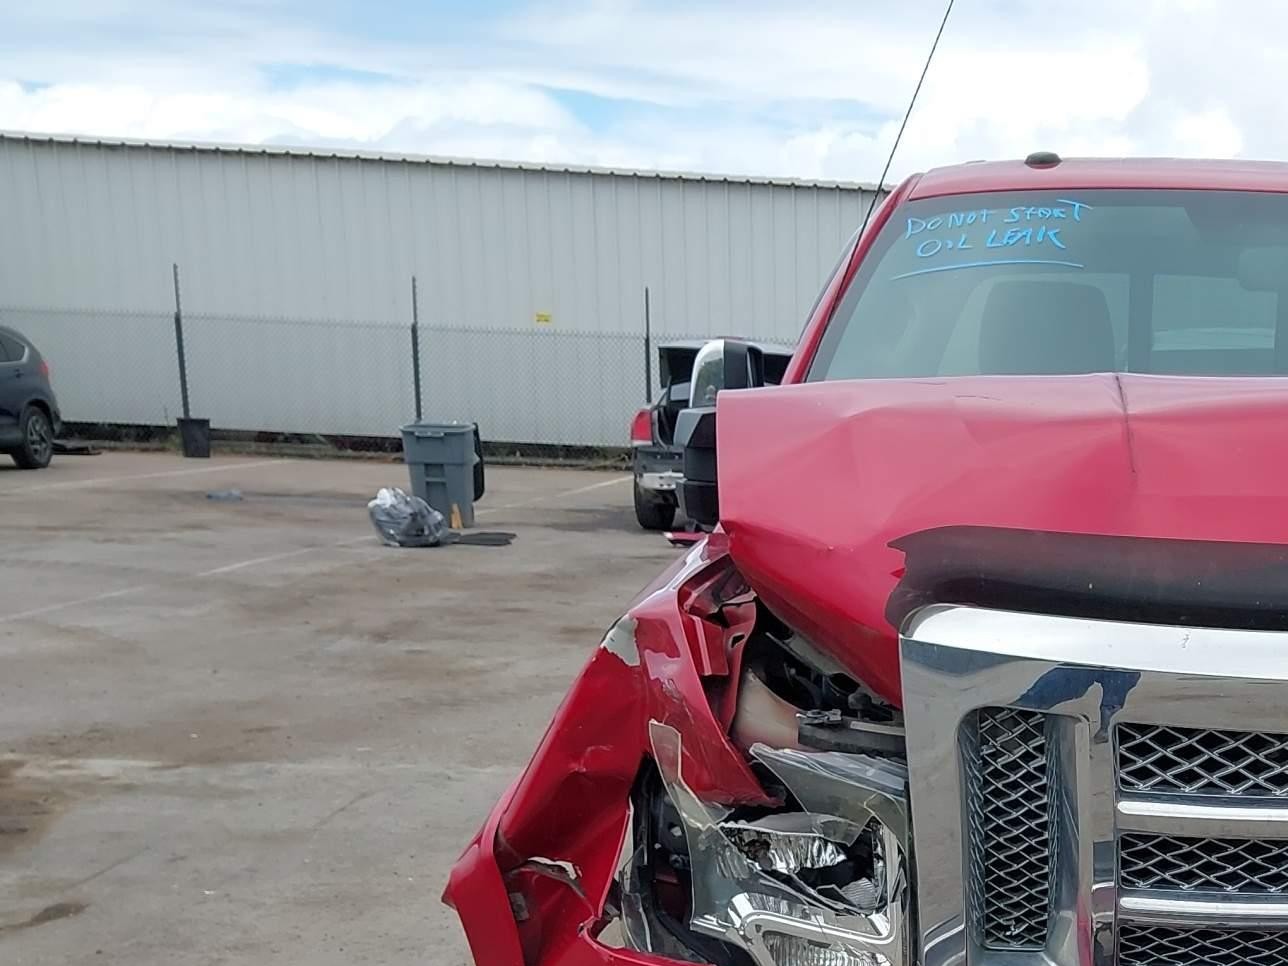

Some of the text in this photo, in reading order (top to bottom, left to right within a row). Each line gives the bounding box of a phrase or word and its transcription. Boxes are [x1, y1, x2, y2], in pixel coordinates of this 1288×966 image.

[905, 199, 1094, 239] DO NOT START
[986, 226, 1066, 249] LEAK
